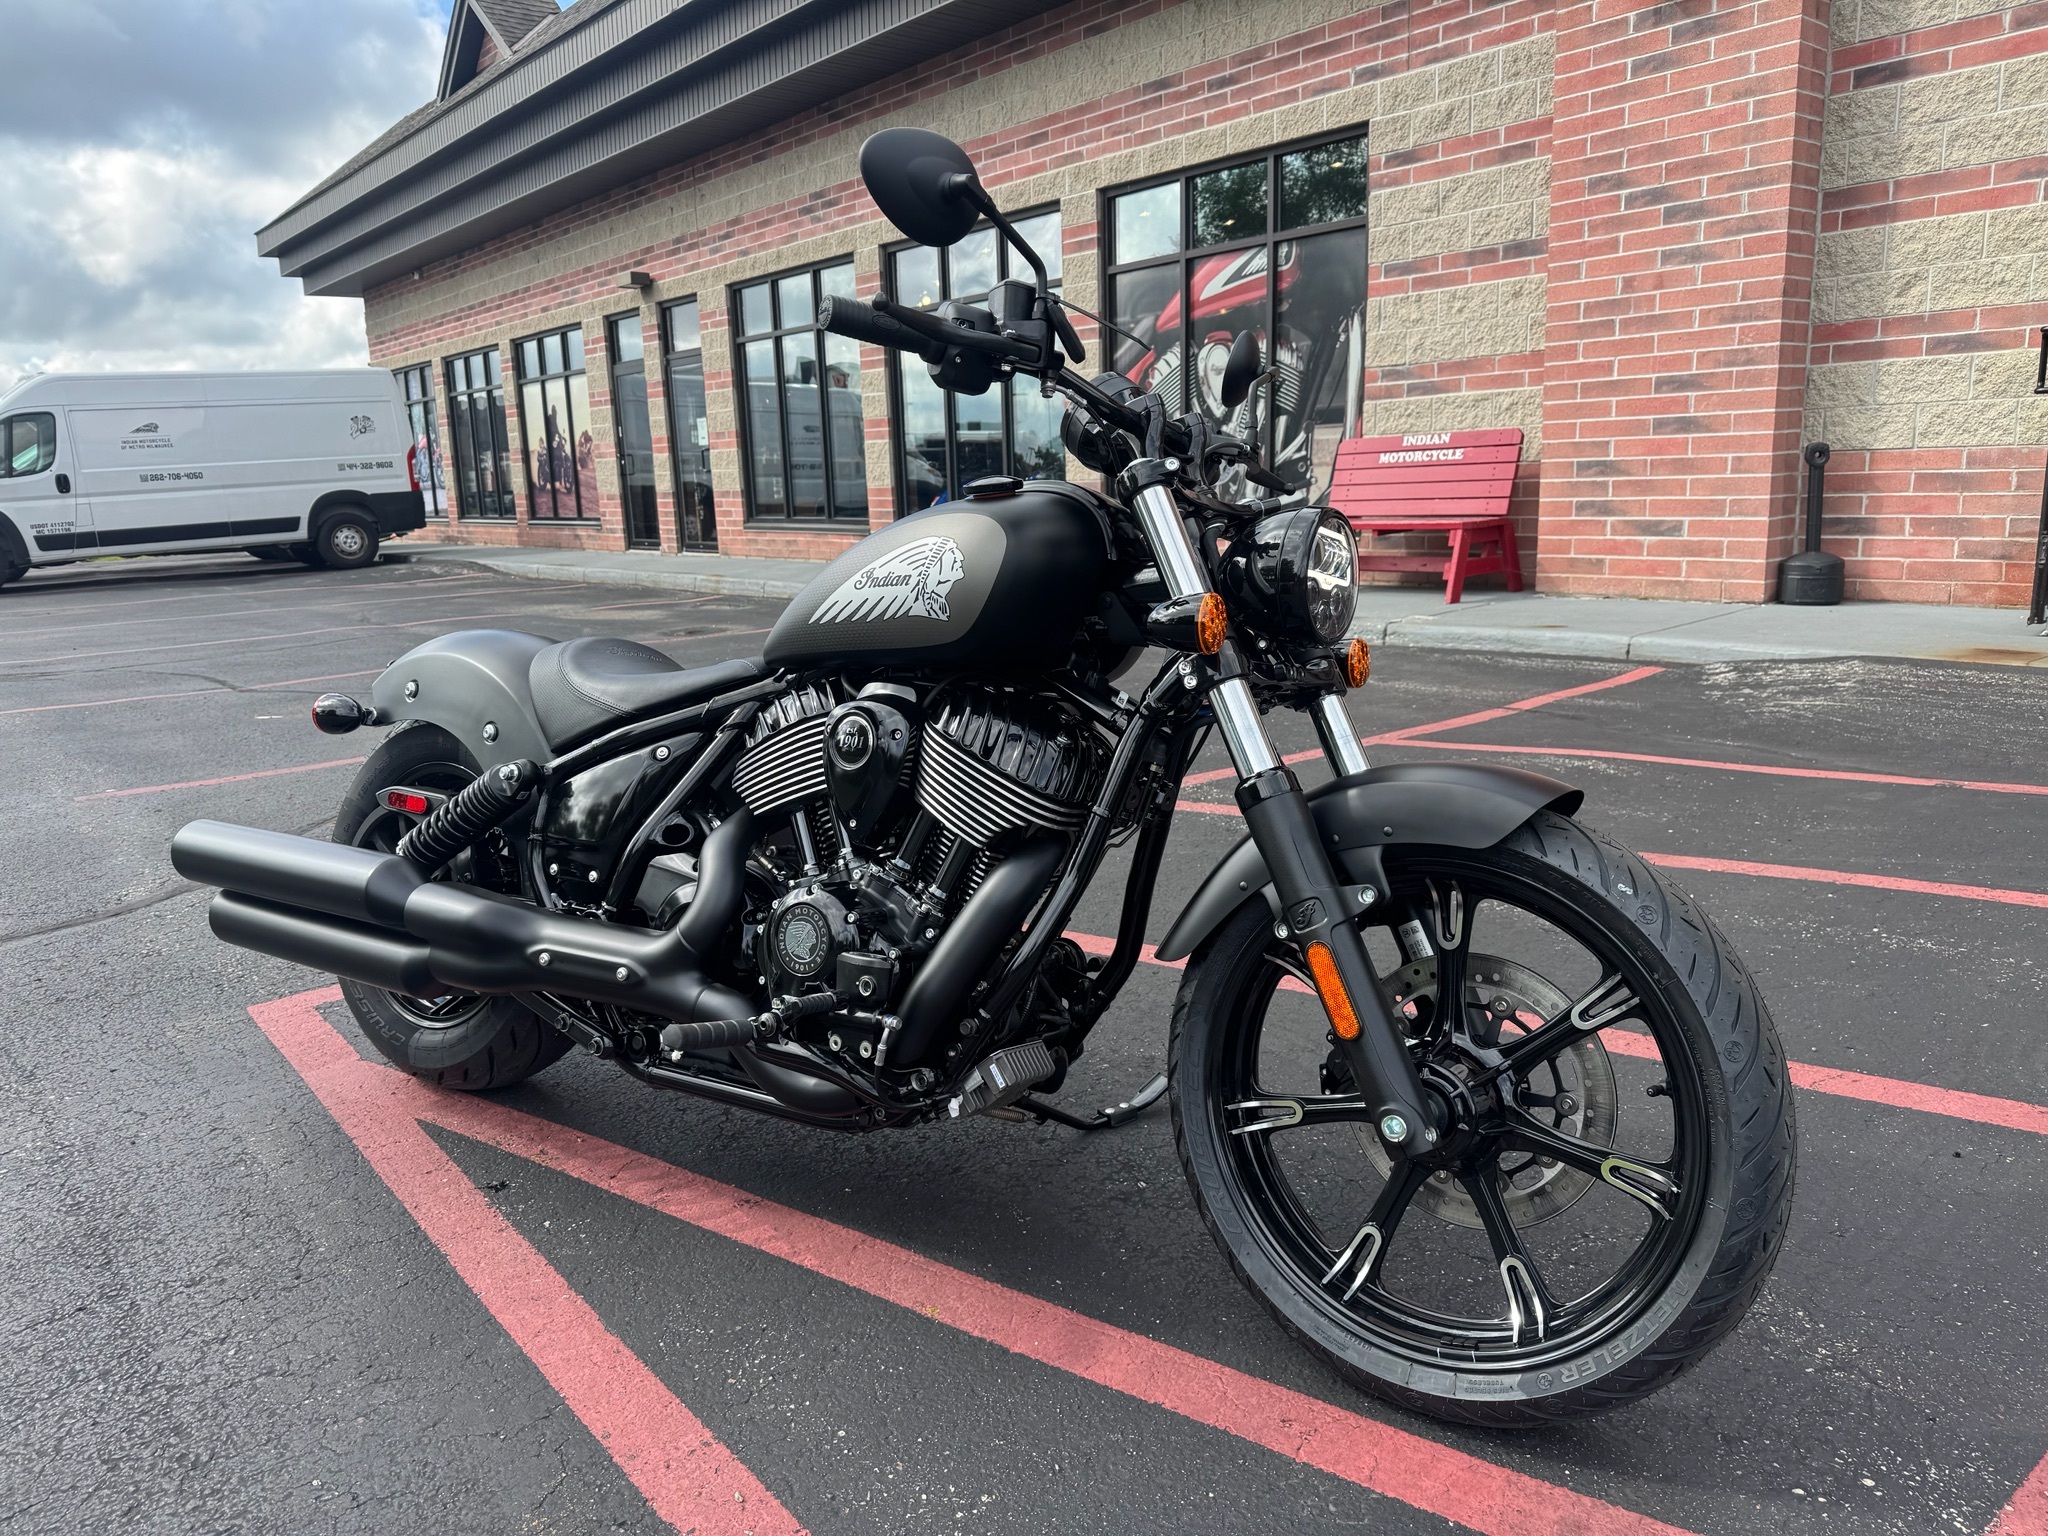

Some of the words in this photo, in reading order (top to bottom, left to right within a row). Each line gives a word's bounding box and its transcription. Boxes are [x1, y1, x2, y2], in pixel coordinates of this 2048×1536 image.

[1402, 433, 1451, 446] INDIAN
[1378, 448, 1464, 464] MOTORCYCLE
[149, 471, 204, 482] 262-706-4050
[853, 566, 912, 591] Indian
[837, 734, 864, 749] 1901
[779, 913, 793, 955] INDIAN
[795, 907, 828, 964] MOTORCYCLE
[347, 980, 406, 1046] CRUISE
[1560, 1281, 1689, 1383] METZELER
